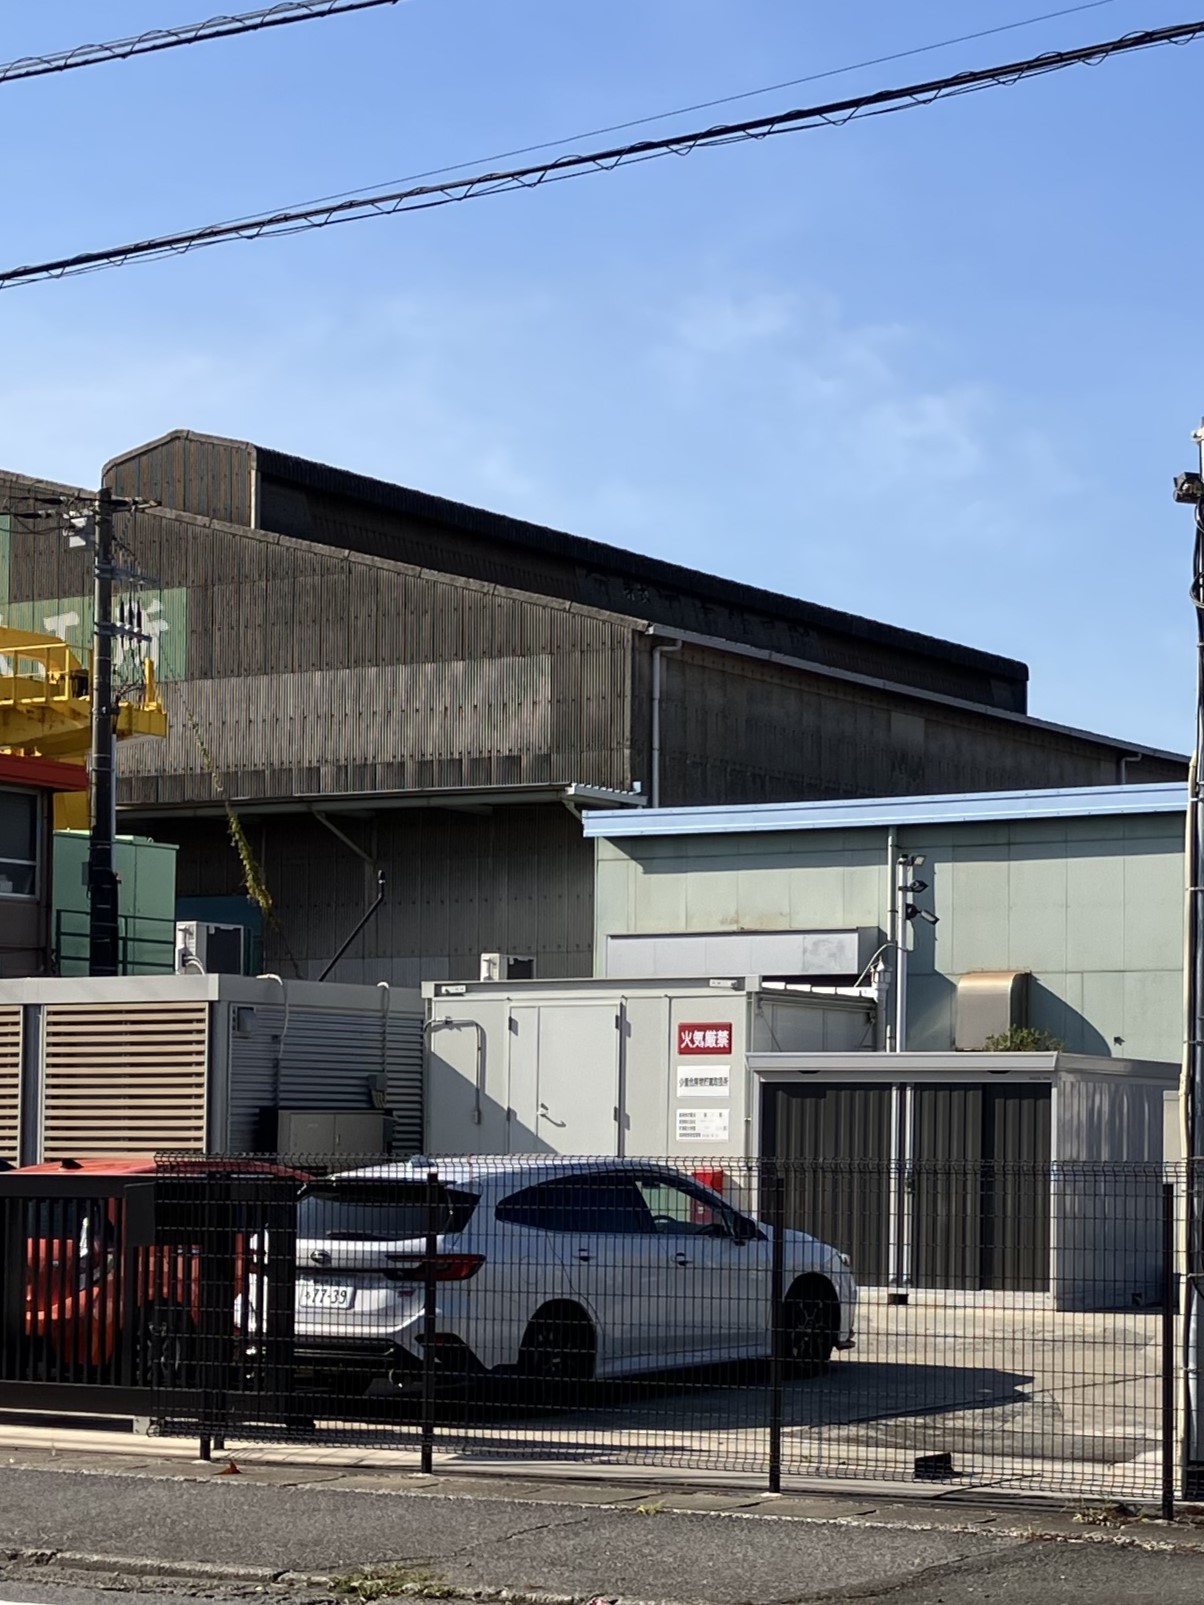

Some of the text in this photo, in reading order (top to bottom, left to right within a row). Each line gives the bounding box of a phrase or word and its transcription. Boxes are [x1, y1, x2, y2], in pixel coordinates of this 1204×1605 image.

[681, 1030, 729, 1048] 火気厳禁
[312, 1288, 347, 1304] 77-39
